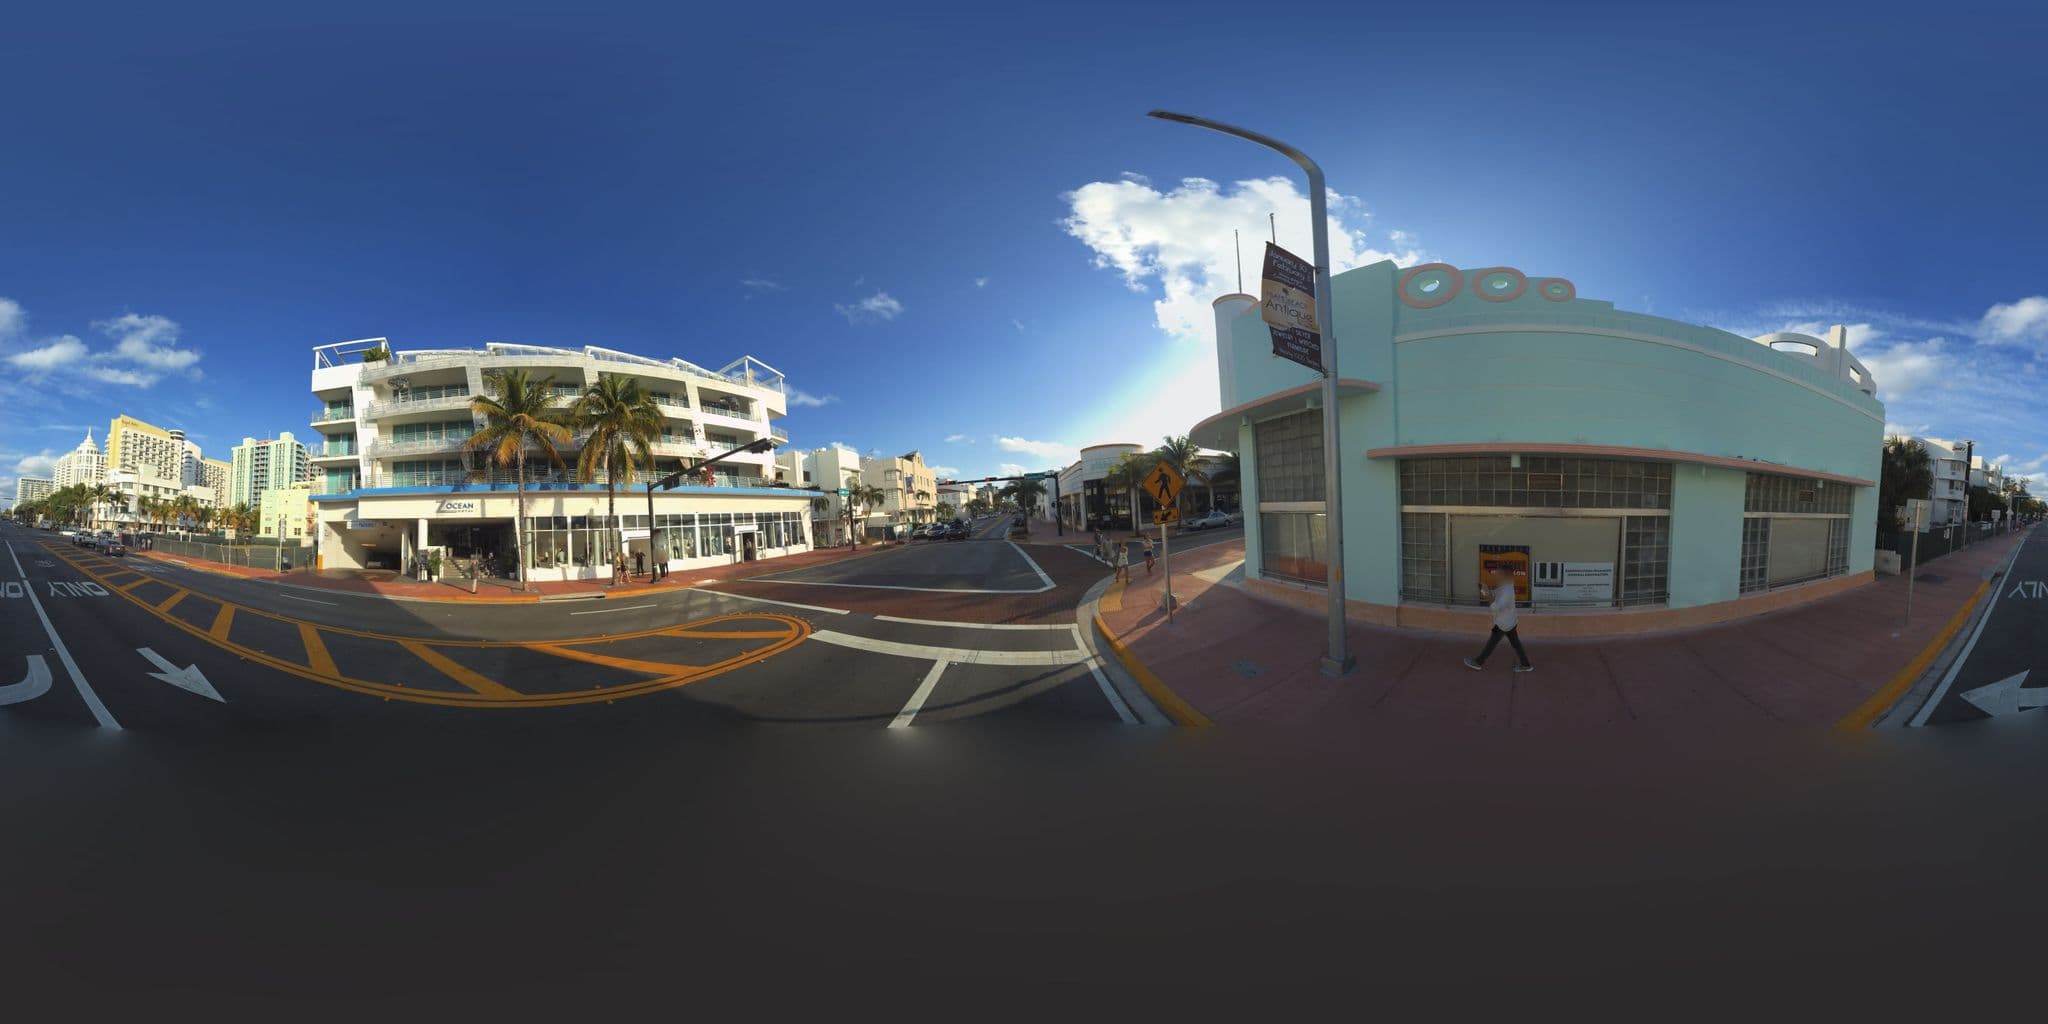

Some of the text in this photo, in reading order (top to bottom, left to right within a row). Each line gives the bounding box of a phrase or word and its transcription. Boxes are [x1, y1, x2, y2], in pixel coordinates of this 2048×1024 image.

[1265, 299, 1313, 322] Antique
[446, 502, 474, 510] OCEAN
[47, 581, 110, 597] ONLY
[2008, 581, 2048, 598] NLY
